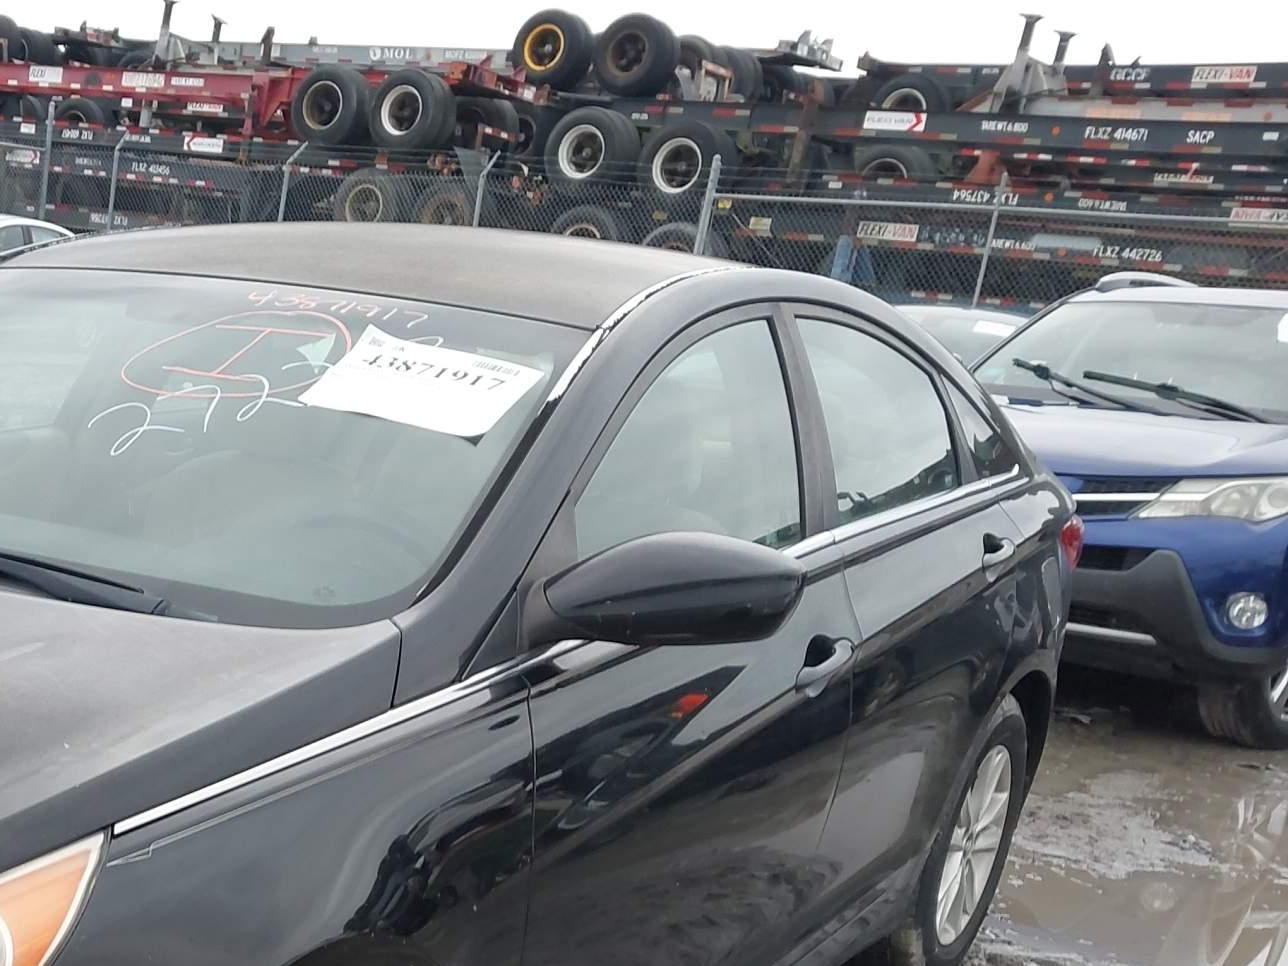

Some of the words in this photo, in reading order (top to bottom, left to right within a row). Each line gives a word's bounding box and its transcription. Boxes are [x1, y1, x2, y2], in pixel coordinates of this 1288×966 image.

[382, 47, 412, 59] MOL
[1195, 66, 1255, 80] FLEXI-VAN
[1084, 126, 1111, 140] FLXZ
[1113, 127, 1149, 142] 414671
[1186, 129, 1215, 144] SACP
[860, 222, 917, 241] FLEXI-VAN
[1093, 245, 1120, 259] FLXZ
[1122, 247, 1163, 262] 442726
[362, 354, 506, 390] 43871917
